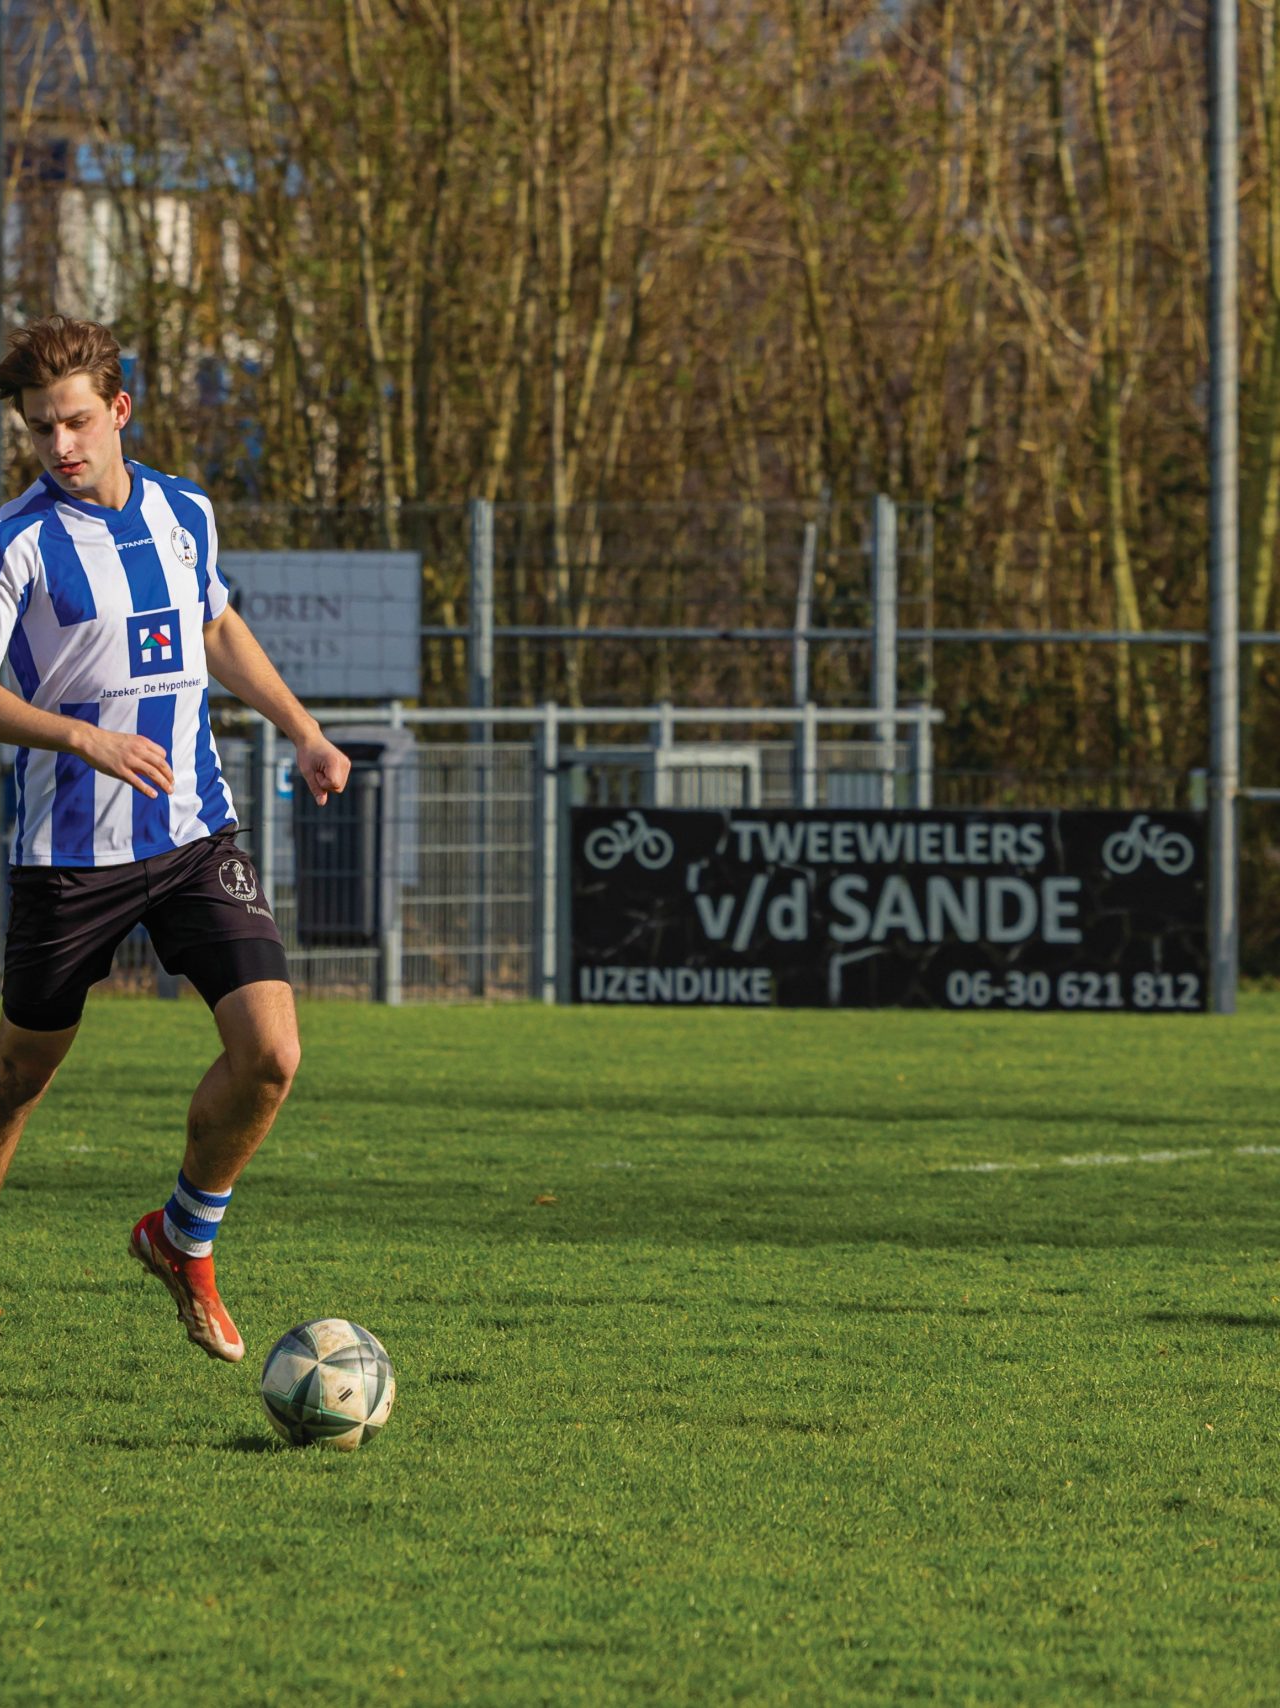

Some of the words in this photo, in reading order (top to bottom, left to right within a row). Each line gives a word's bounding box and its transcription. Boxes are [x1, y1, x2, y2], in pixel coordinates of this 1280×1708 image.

[116, 537, 154, 551] STANNO
[100, 687, 141, 699] Jazeker.
[144, 684, 156, 693] De
[730, 821, 1045, 864] TWEEWIELERS
[694, 873, 808, 952] v/d
[828, 874, 1083, 943] SANDE
[580, 967, 773, 1002] IJZENDIJKE
[946, 970, 1051, 1006] 06-30
[1057, 972, 1123, 1007] 621
[1132, 973, 1200, 1008] 812
